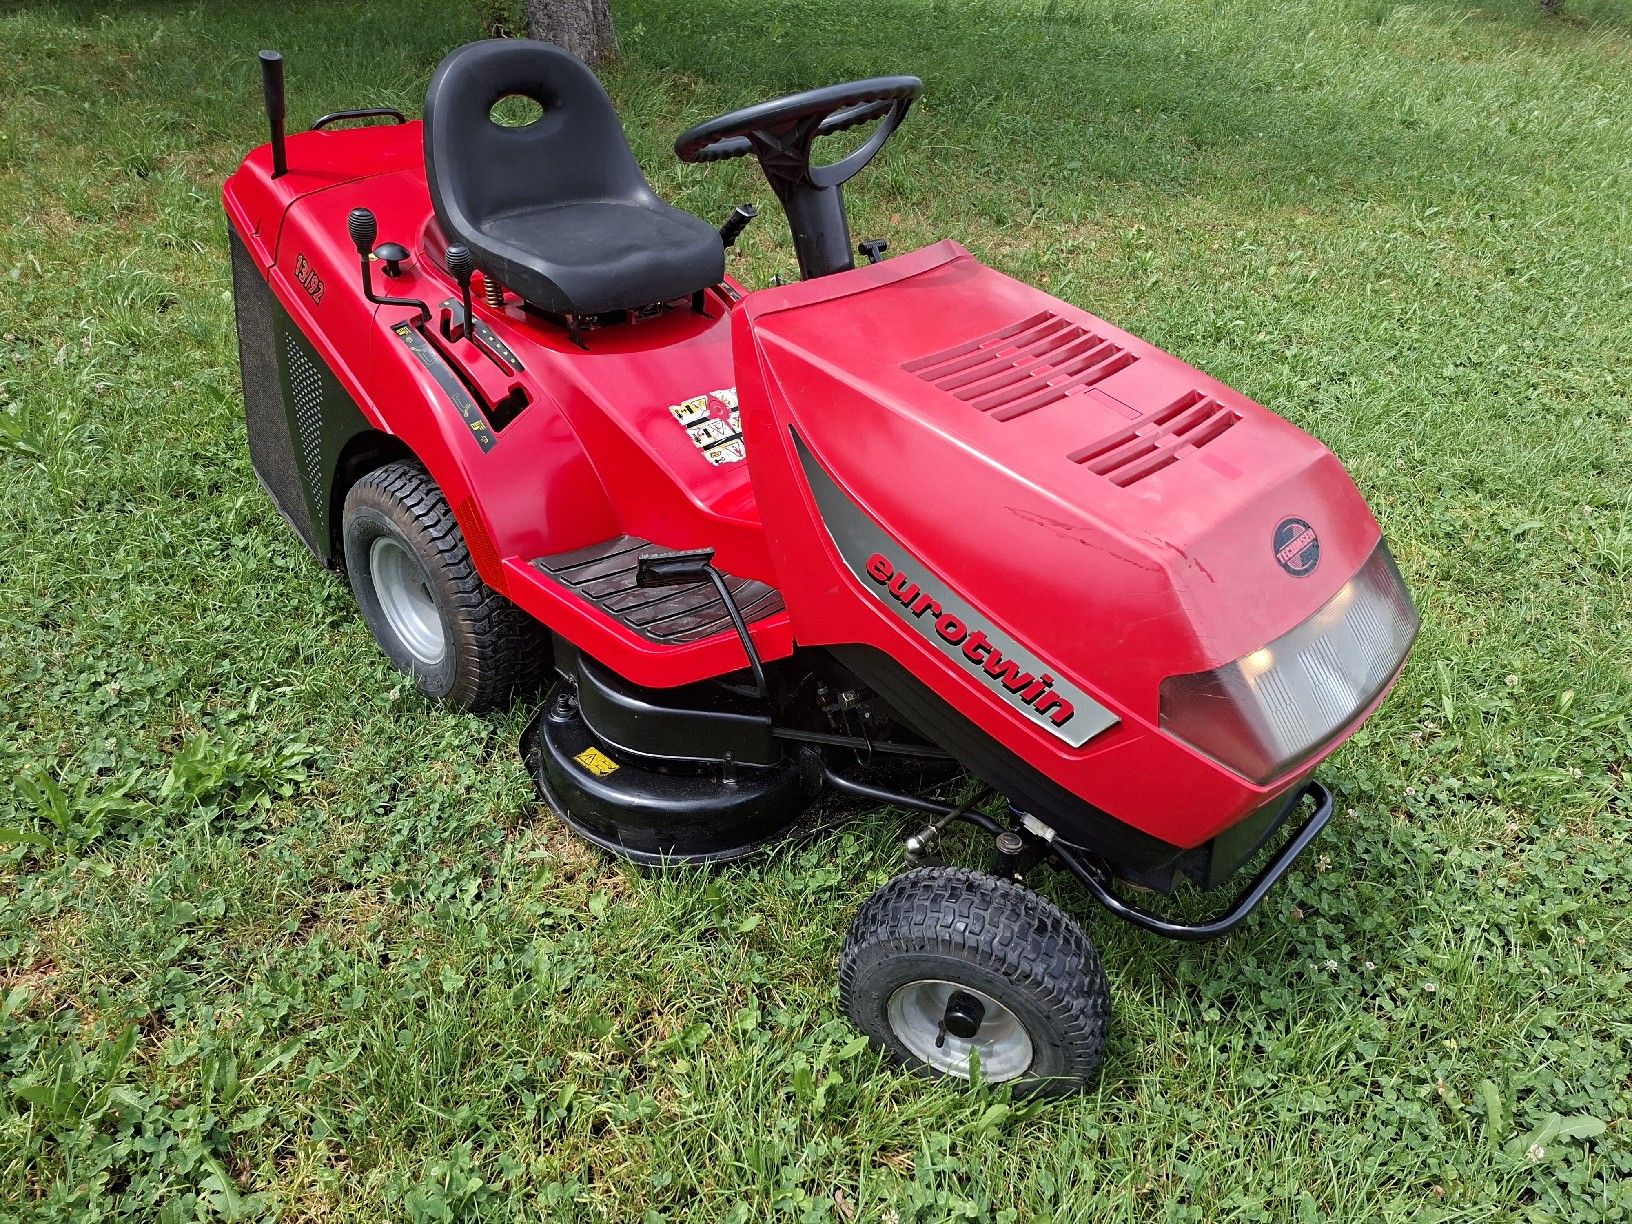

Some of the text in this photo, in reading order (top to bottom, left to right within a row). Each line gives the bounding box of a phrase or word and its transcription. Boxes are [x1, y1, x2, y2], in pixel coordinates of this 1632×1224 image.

[294, 253, 325, 305] 13/92
[1276, 528, 1316, 564] TECUMSEH
[866, 553, 1075, 728] eurotwin
